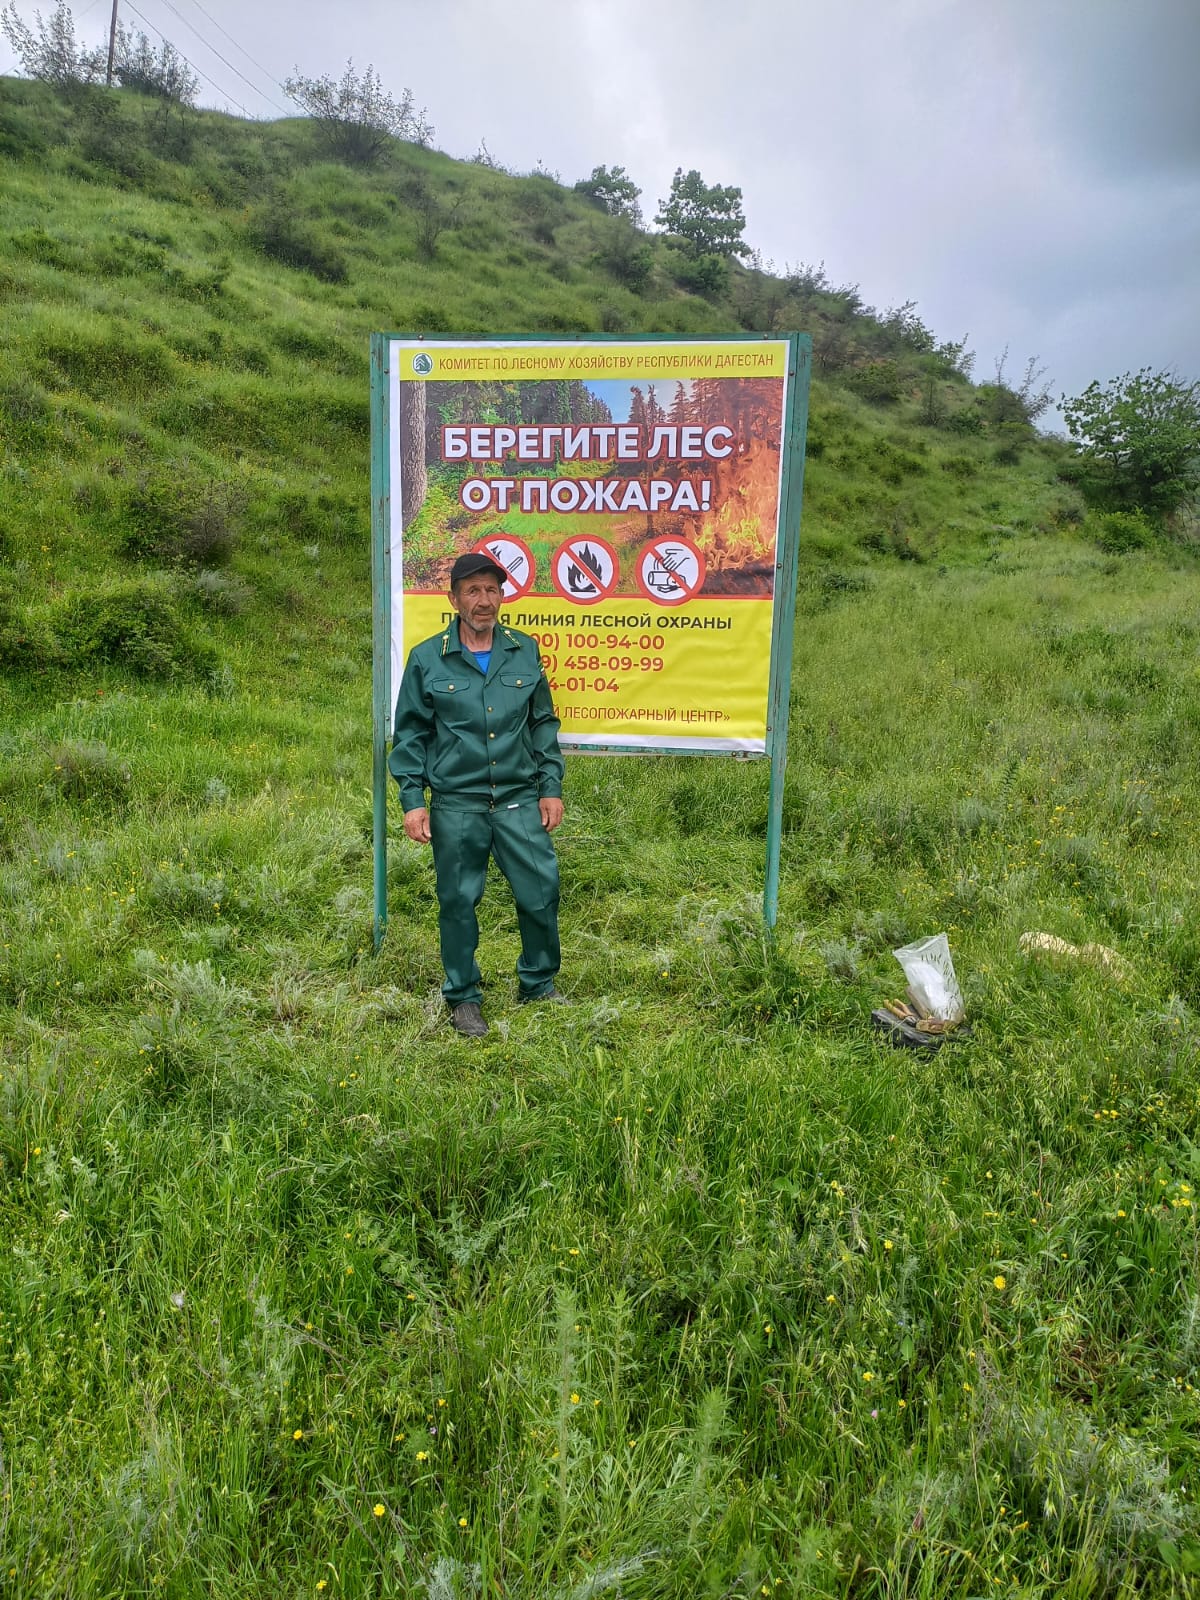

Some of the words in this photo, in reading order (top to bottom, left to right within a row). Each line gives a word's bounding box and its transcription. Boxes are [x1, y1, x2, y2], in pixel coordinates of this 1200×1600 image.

[439, 358, 491, 370] КОМИТЕТ
[493, 358, 508, 370] ПО
[511, 357, 566, 369] ЛЕСНОМУ
[568, 355, 634, 369] ХОЗЯЙСТВУ
[637, 355, 712, 368] РЕСПУБЛИКИ
[715, 354, 774, 369] ДАГЕСТАН
[443, 427, 639, 459] БЕРЕГИТЕ
[647, 425, 734, 458] ЛЕС
[461, 479, 514, 512] ОТ
[522, 479, 712, 512] ПОЖАРА!
[515, 613, 575, 626] ЛИНИЯ
[580, 613, 651, 628] ЛЕСНОЙ
[656, 616, 732, 629] ОХРАНЫ
[566, 633, 665, 650] 100-94-00
[564, 655, 664, 672] 458-09-99
[549, 676, 620, 692] 4-01-04
[564, 706, 677, 722] ЛЕСОПОЖАРНЫЙ
[680, 709, 731, 724] ЦЕНТР»
